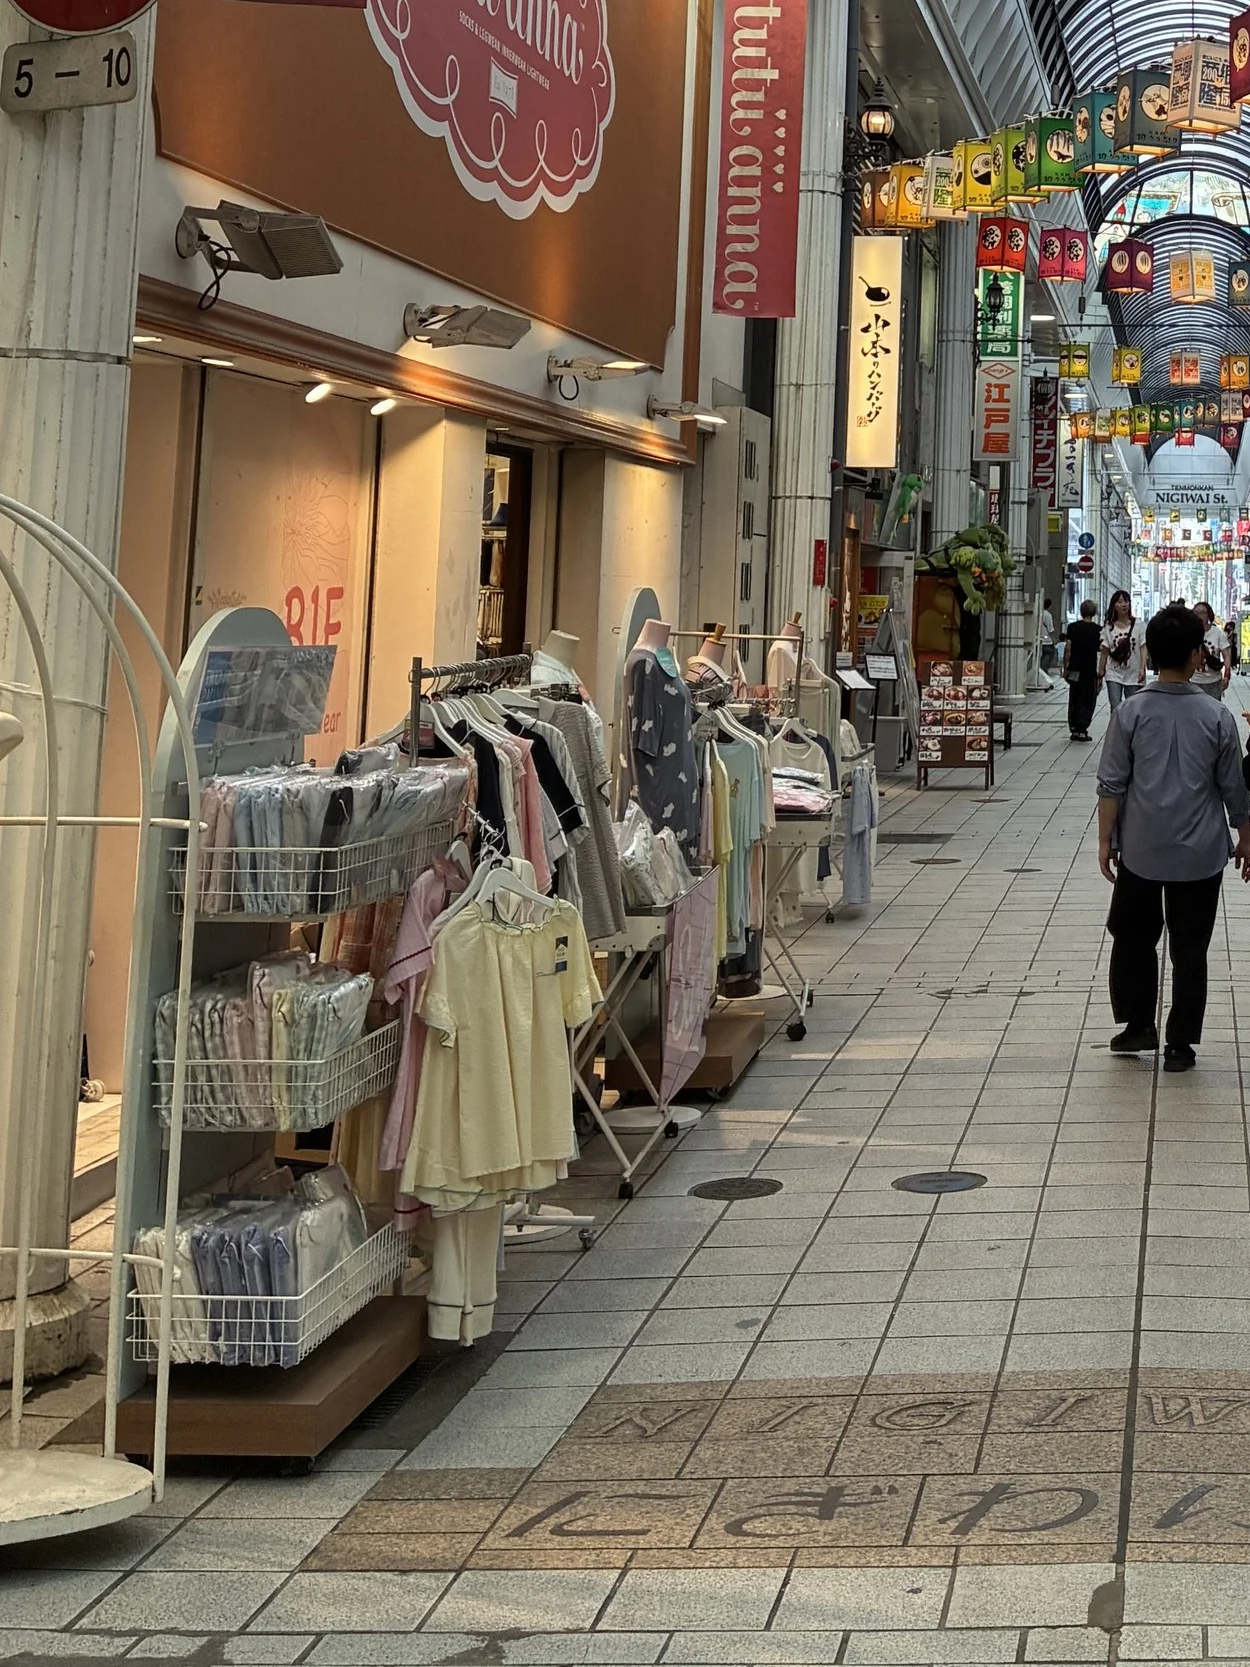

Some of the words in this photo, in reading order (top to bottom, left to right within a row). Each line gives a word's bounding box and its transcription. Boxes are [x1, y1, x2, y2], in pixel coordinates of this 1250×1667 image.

[14, 58, 34, 99] 5
[102, 46, 131, 88] 10
[459, 10, 474, 32] SOCKS
[479, 26, 501, 53] LEGWEAR
[501, 44, 526, 73] INNERWEAR
[527, 64, 550, 91] LIGHTWEAR
[722, 145, 764, 310] anna
[860, 313, 891, 423] 山本のハンバーグ
[982, 382, 1011, 454] 江戸屋
[1155, 492, 1210, 504] NIGIWAI
[1213, 494, 1228, 504] St.
